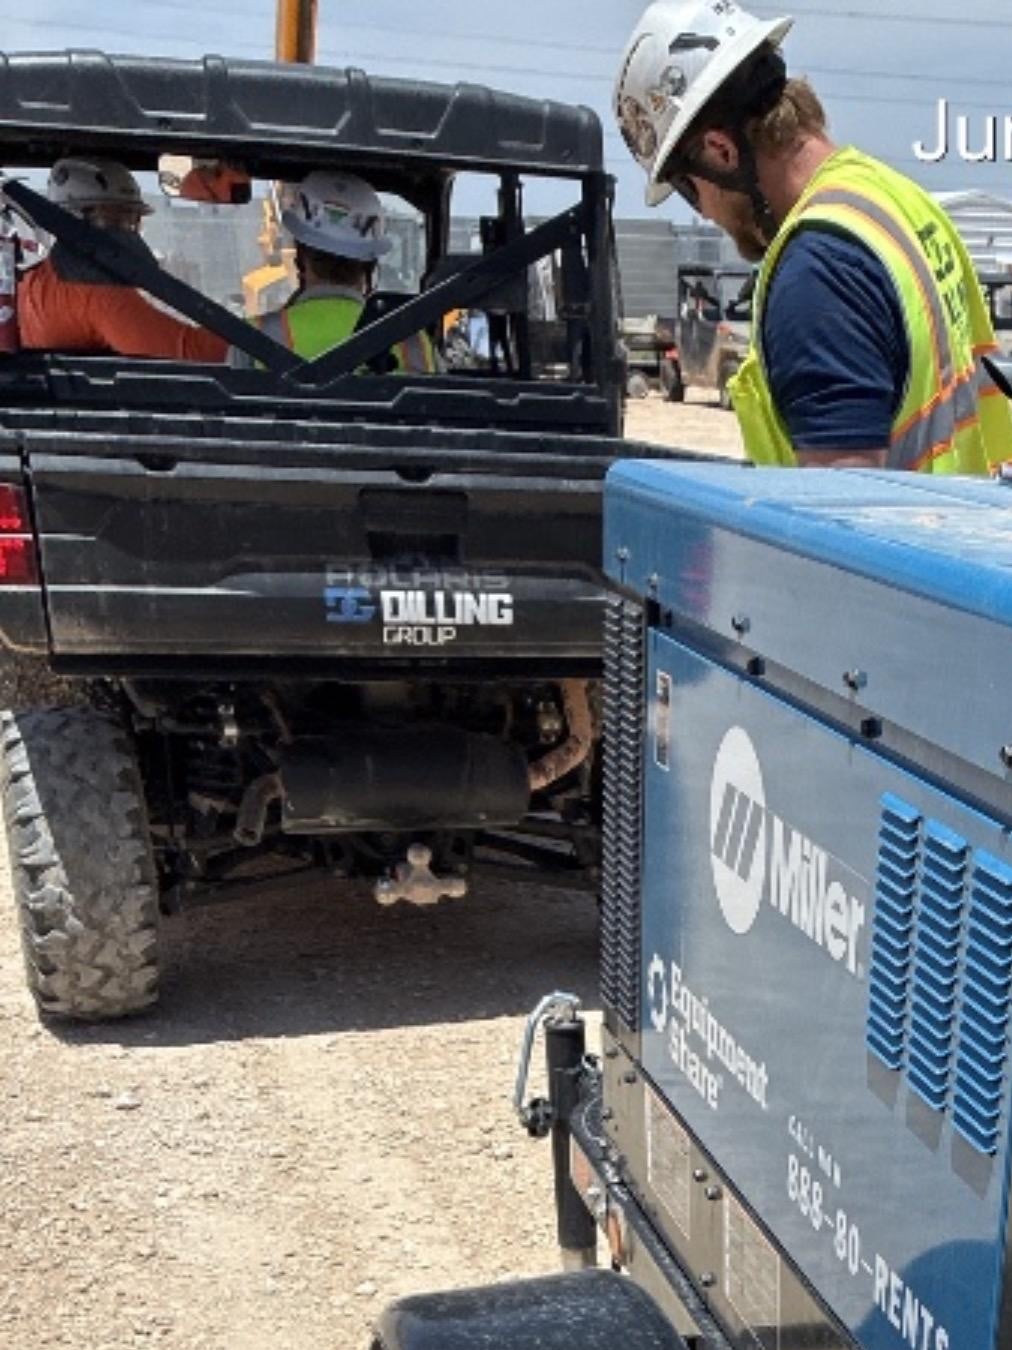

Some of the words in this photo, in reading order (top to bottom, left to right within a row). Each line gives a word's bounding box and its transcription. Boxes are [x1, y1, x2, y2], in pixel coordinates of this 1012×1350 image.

[380, 590, 514, 625] DILLING
[382, 625, 457, 645] GROUP
[770, 814, 865, 974] Miller
[671, 960, 769, 1110] Equipment
